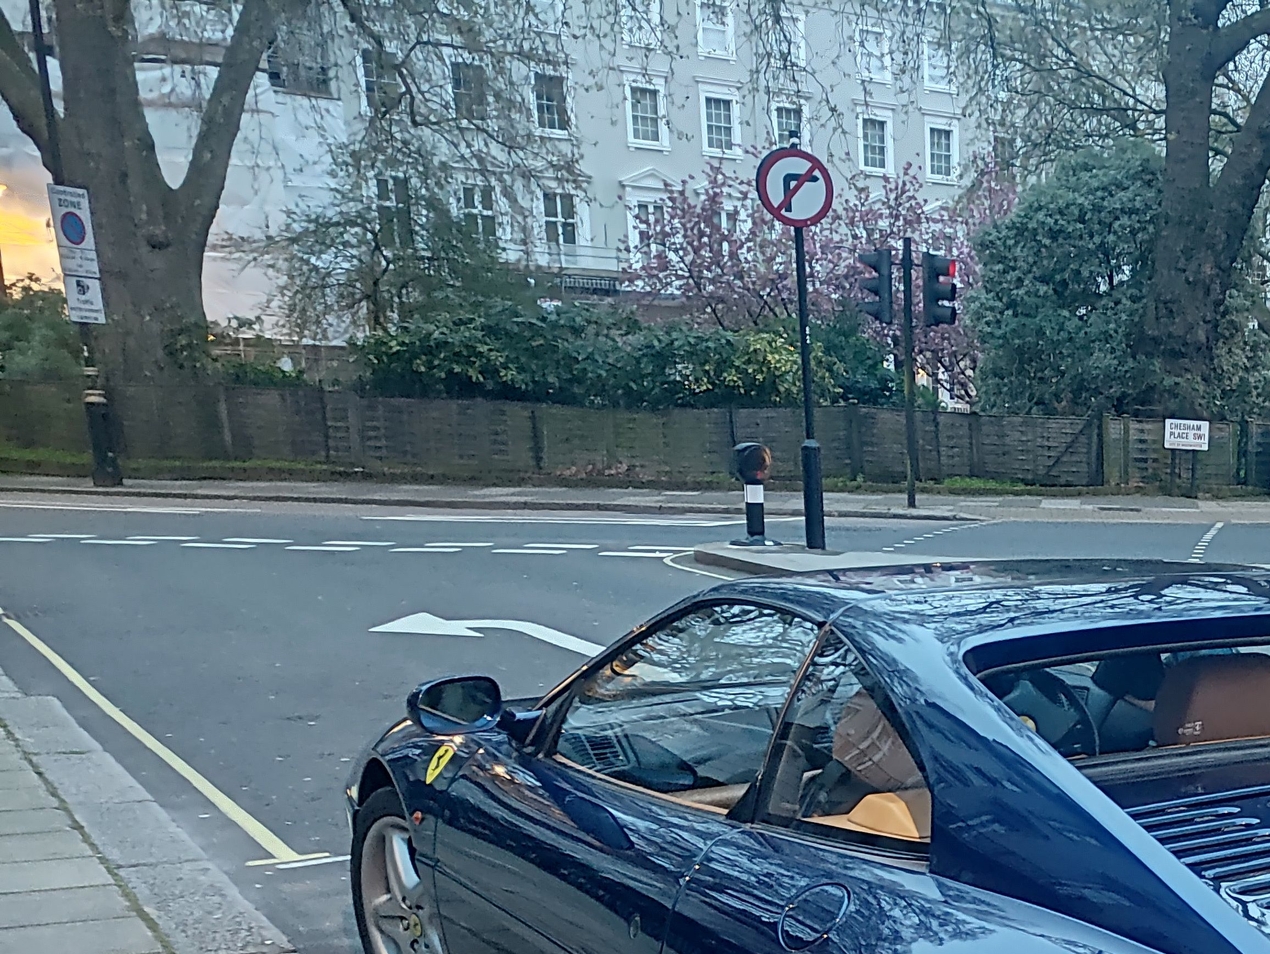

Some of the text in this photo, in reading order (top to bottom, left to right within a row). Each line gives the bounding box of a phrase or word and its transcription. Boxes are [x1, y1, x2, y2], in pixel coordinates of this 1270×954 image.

[58, 198, 83, 210] ZONE
[1170, 422, 1202, 432] CHESHAM
[1170, 431, 1189, 440] PLACE
